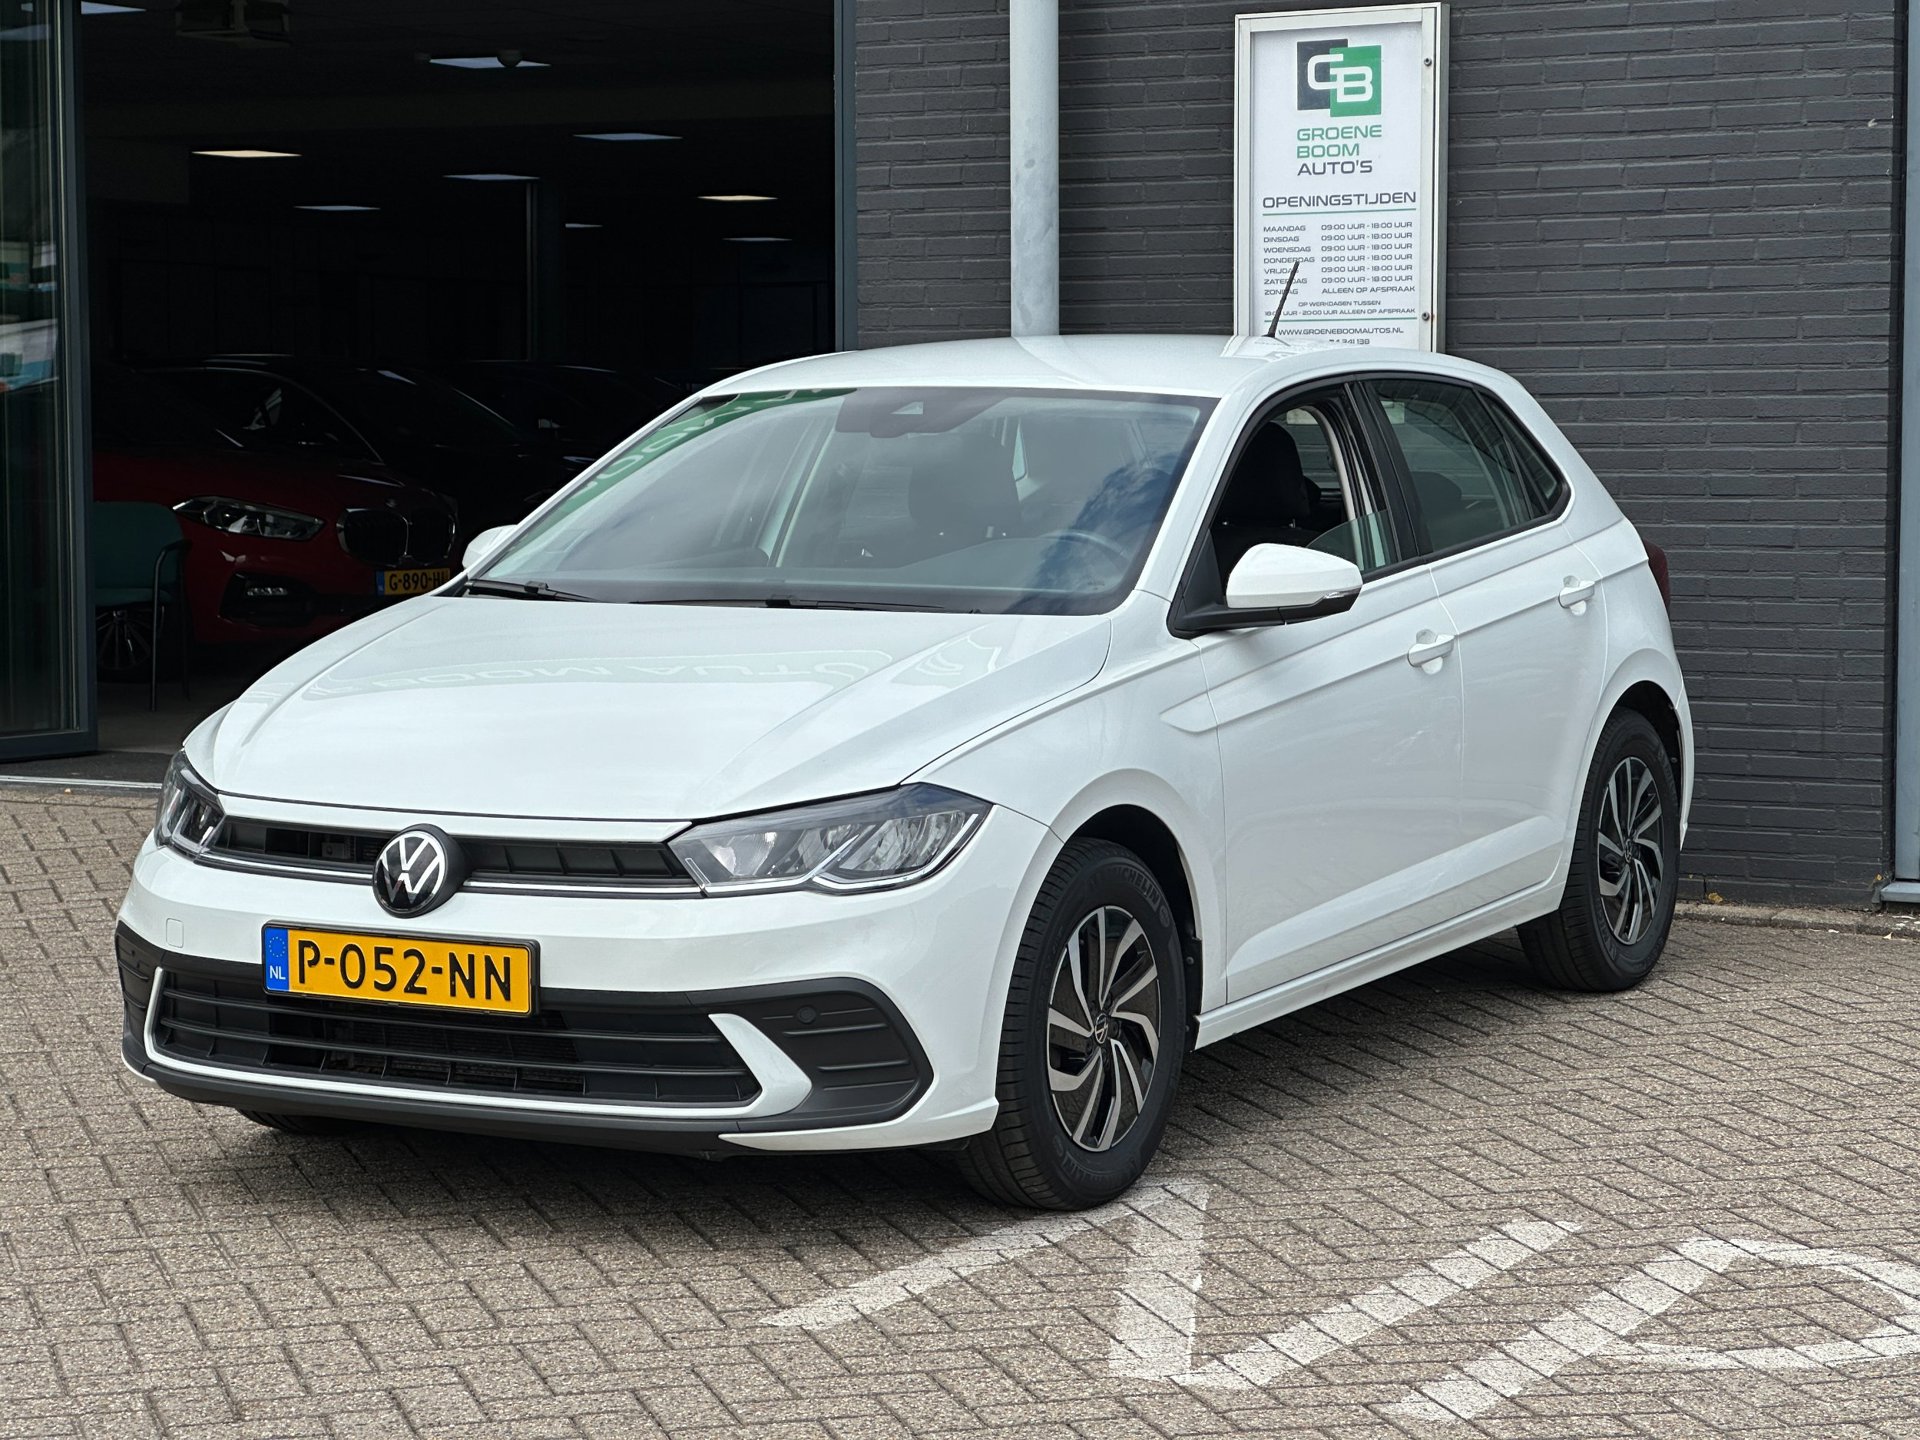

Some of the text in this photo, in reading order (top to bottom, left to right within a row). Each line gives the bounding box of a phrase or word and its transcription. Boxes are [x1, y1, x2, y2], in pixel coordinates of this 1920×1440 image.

[1297, 124, 1382, 141] GROENE
[1297, 143, 1360, 159] BOOM
[1297, 160, 1373, 176] AUTO'S
[1262, 191, 1417, 208] OPENINGSTIJDEN
[1279, 328, 1404, 336] WWW.GROENEBOOMAUTOS.NL
[269, 965, 286, 980] NL
[298, 939, 511, 1001] P-052-NN
